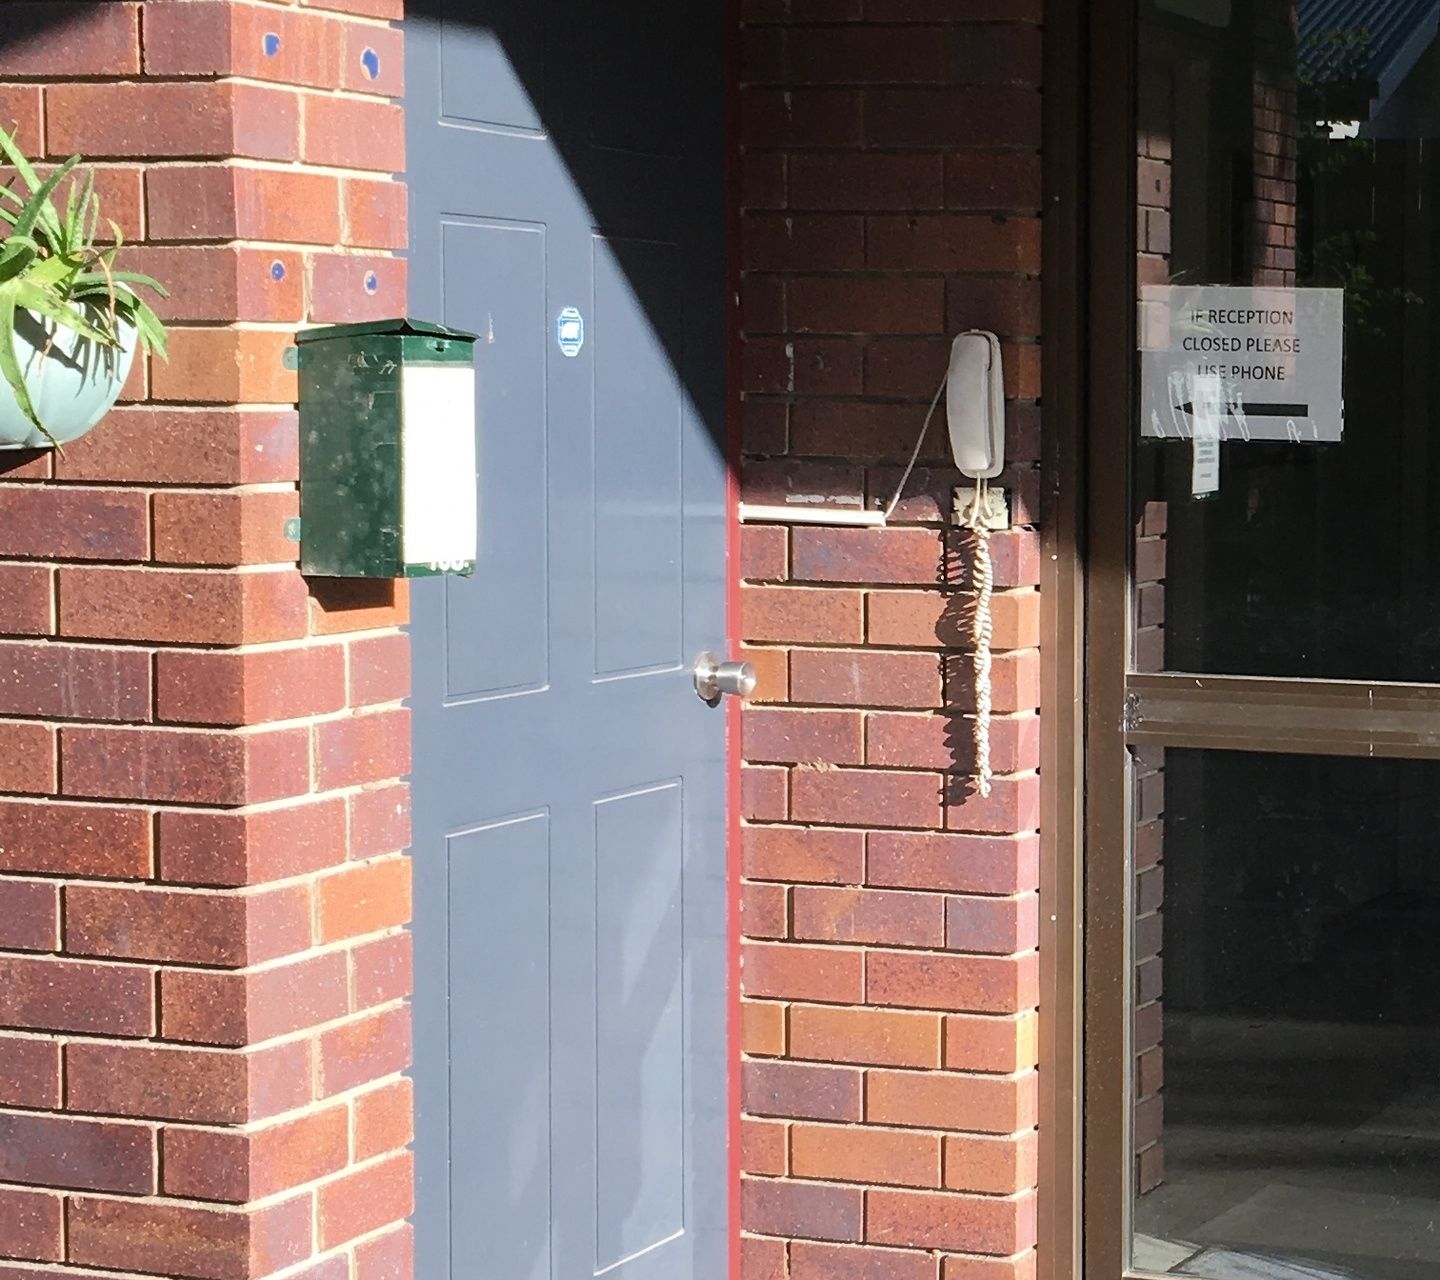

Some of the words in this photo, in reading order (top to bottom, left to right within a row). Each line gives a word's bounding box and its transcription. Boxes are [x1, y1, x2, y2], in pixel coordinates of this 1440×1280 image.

[1208, 310, 1294, 325] RECEPTION
[1182, 336, 1242, 352] CLOSED
[1246, 338, 1301, 353] PLEASE
[1231, 365, 1285, 380] PHONE
